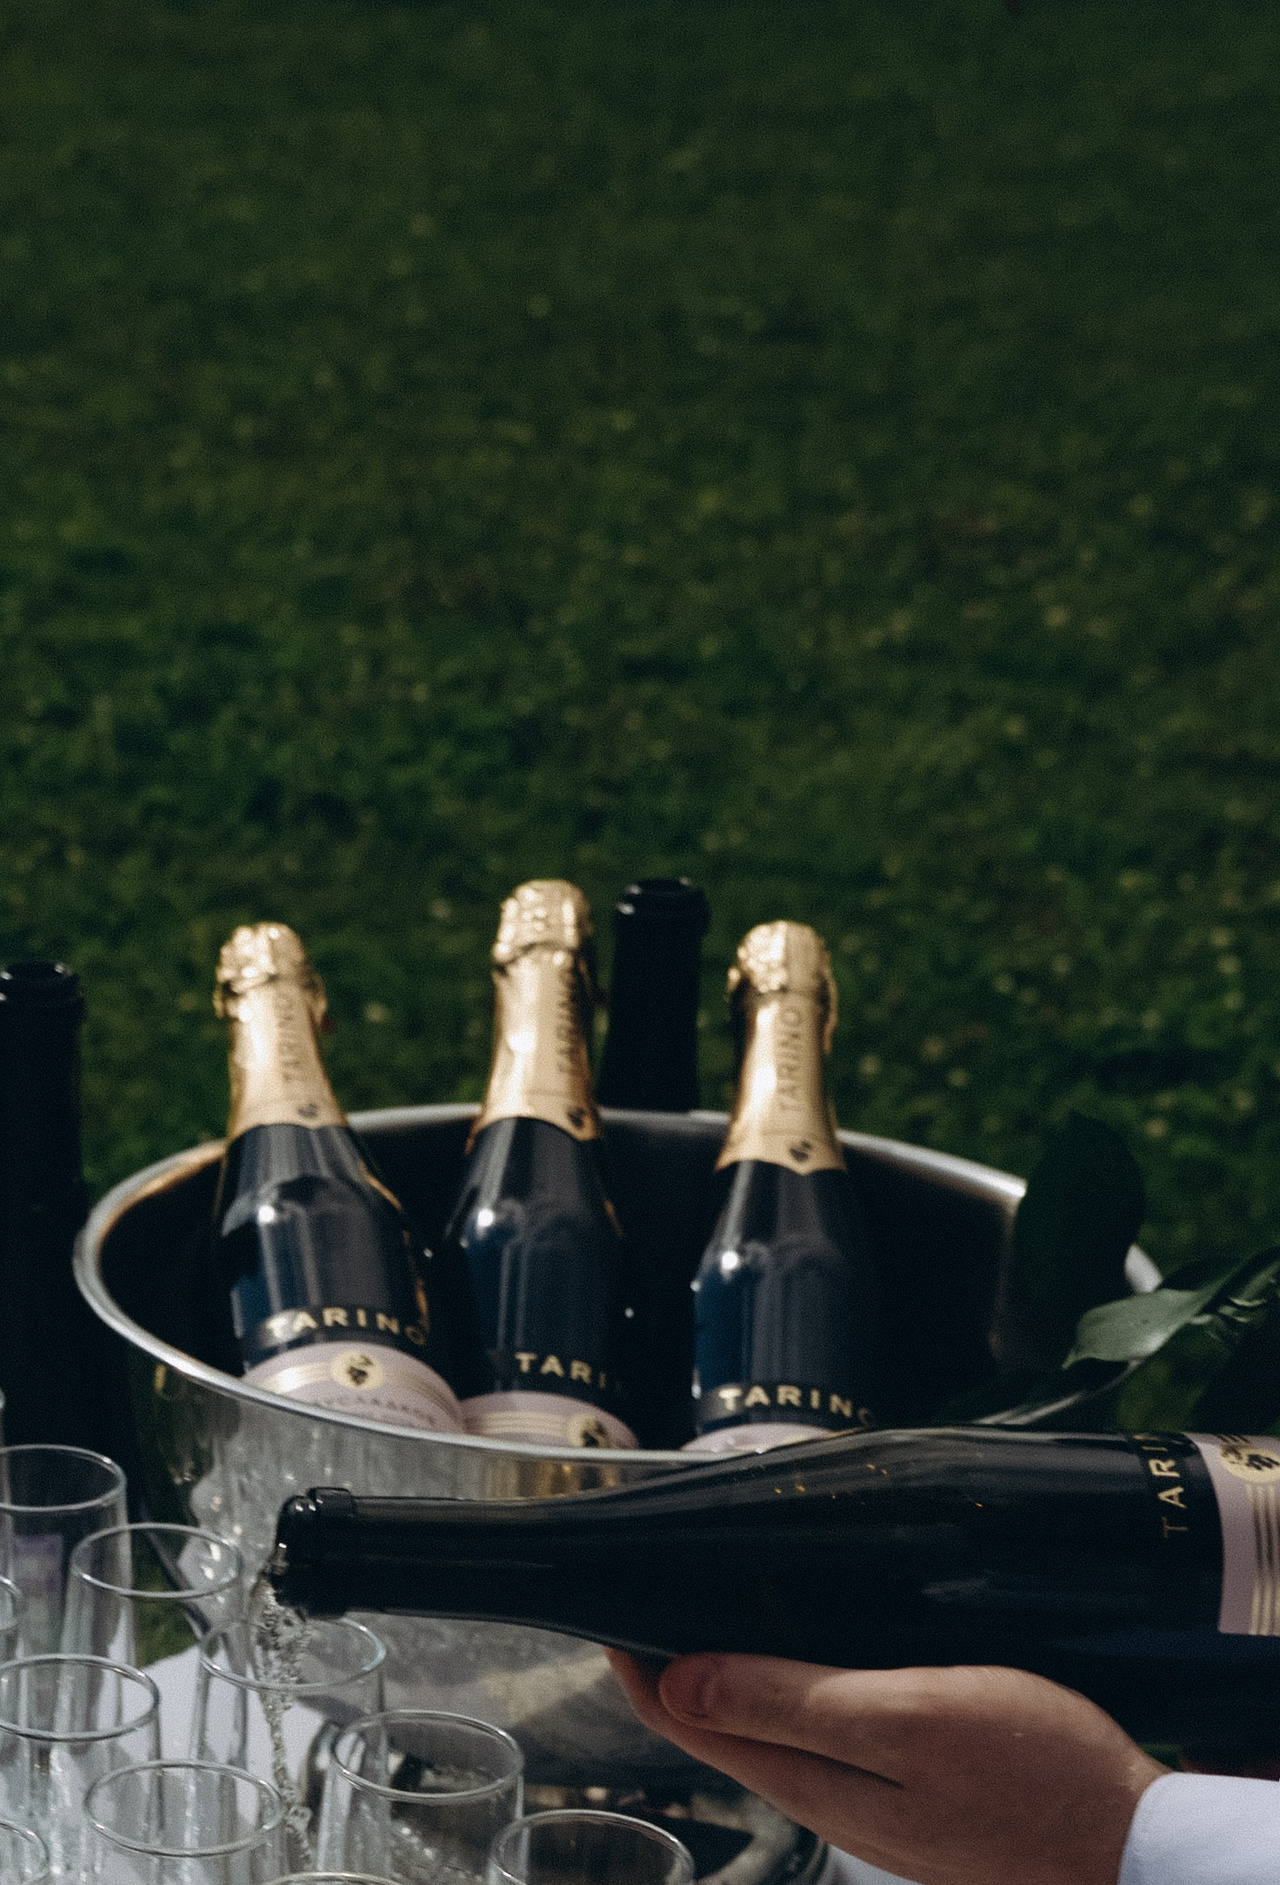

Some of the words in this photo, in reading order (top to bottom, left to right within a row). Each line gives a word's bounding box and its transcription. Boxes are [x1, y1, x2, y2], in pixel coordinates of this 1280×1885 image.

[776, 1005, 806, 1113] TARINO
[515, 1351, 607, 1389] TARI
[1133, 1434, 1188, 1538] TARI
